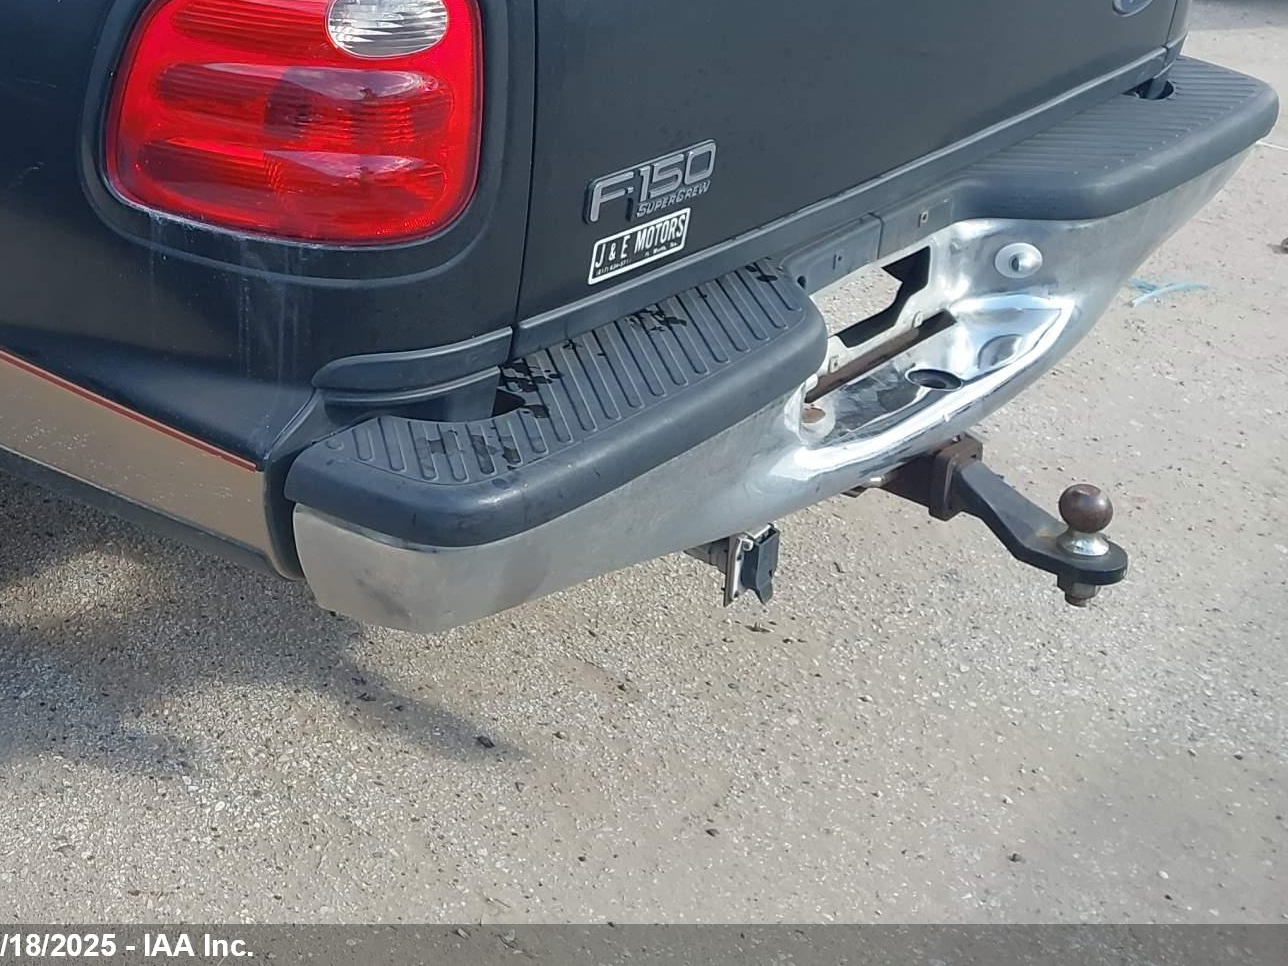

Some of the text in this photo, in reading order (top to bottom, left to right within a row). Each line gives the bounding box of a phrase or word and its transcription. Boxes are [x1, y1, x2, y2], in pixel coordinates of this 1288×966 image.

[595, 243, 607, 268] J
[608, 242, 617, 262] &
[620, 235, 631, 259] E
[634, 214, 686, 255] MOTORS
